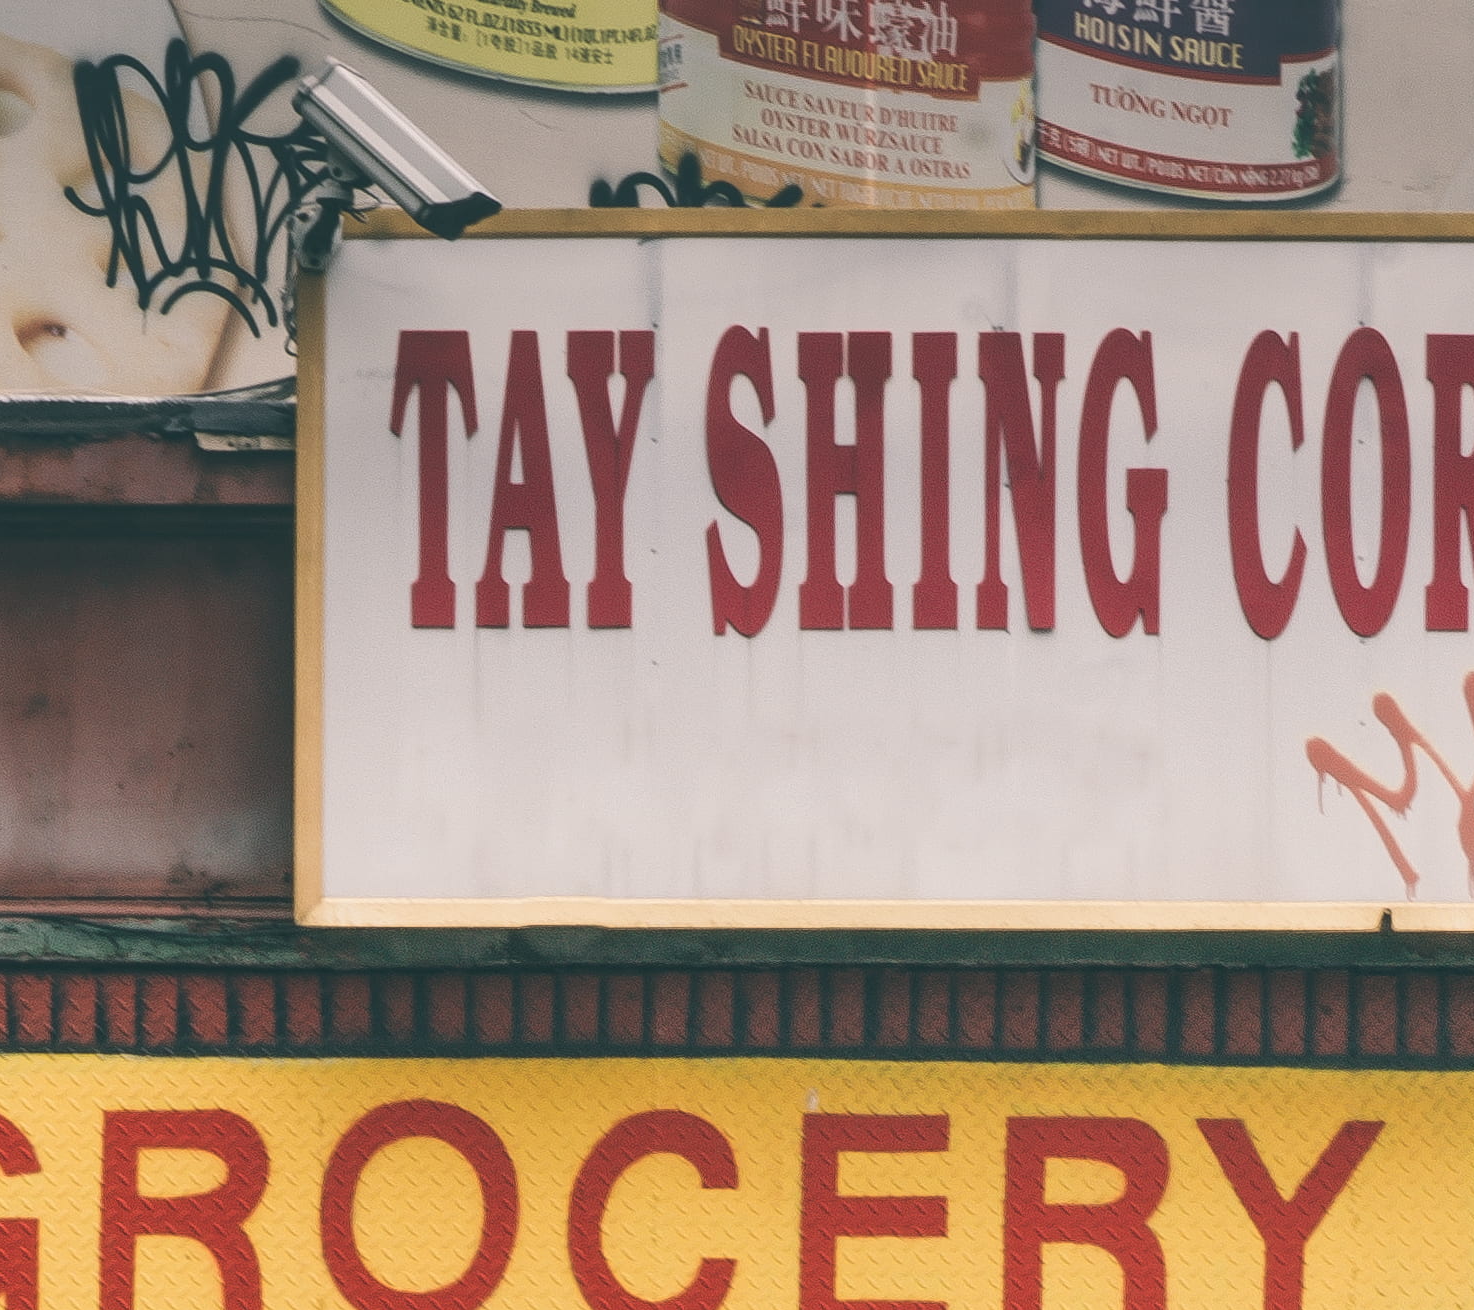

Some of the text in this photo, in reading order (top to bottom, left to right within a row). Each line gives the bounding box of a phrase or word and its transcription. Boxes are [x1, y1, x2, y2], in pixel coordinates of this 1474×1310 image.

[732, 24, 798, 66] OYSTER
[916, 60, 970, 92] SAUCE
[1074, 11, 1244, 70] HOISIN SAUCE
[744, 79, 799, 110] SAUCE
[803, 94, 876, 124] SAVEUR
[760, 108, 831, 140] OYSTER
[731, 123, 783, 152] SALSA
[787, 138, 825, 162] CON
[828, 146, 890, 174] SABOR
[892, 156, 907, 176] A
[909, 156, 973, 181] OSTRAS
[389, 329, 655, 630] TAY
[705, 324, 1169, 640] SHING
